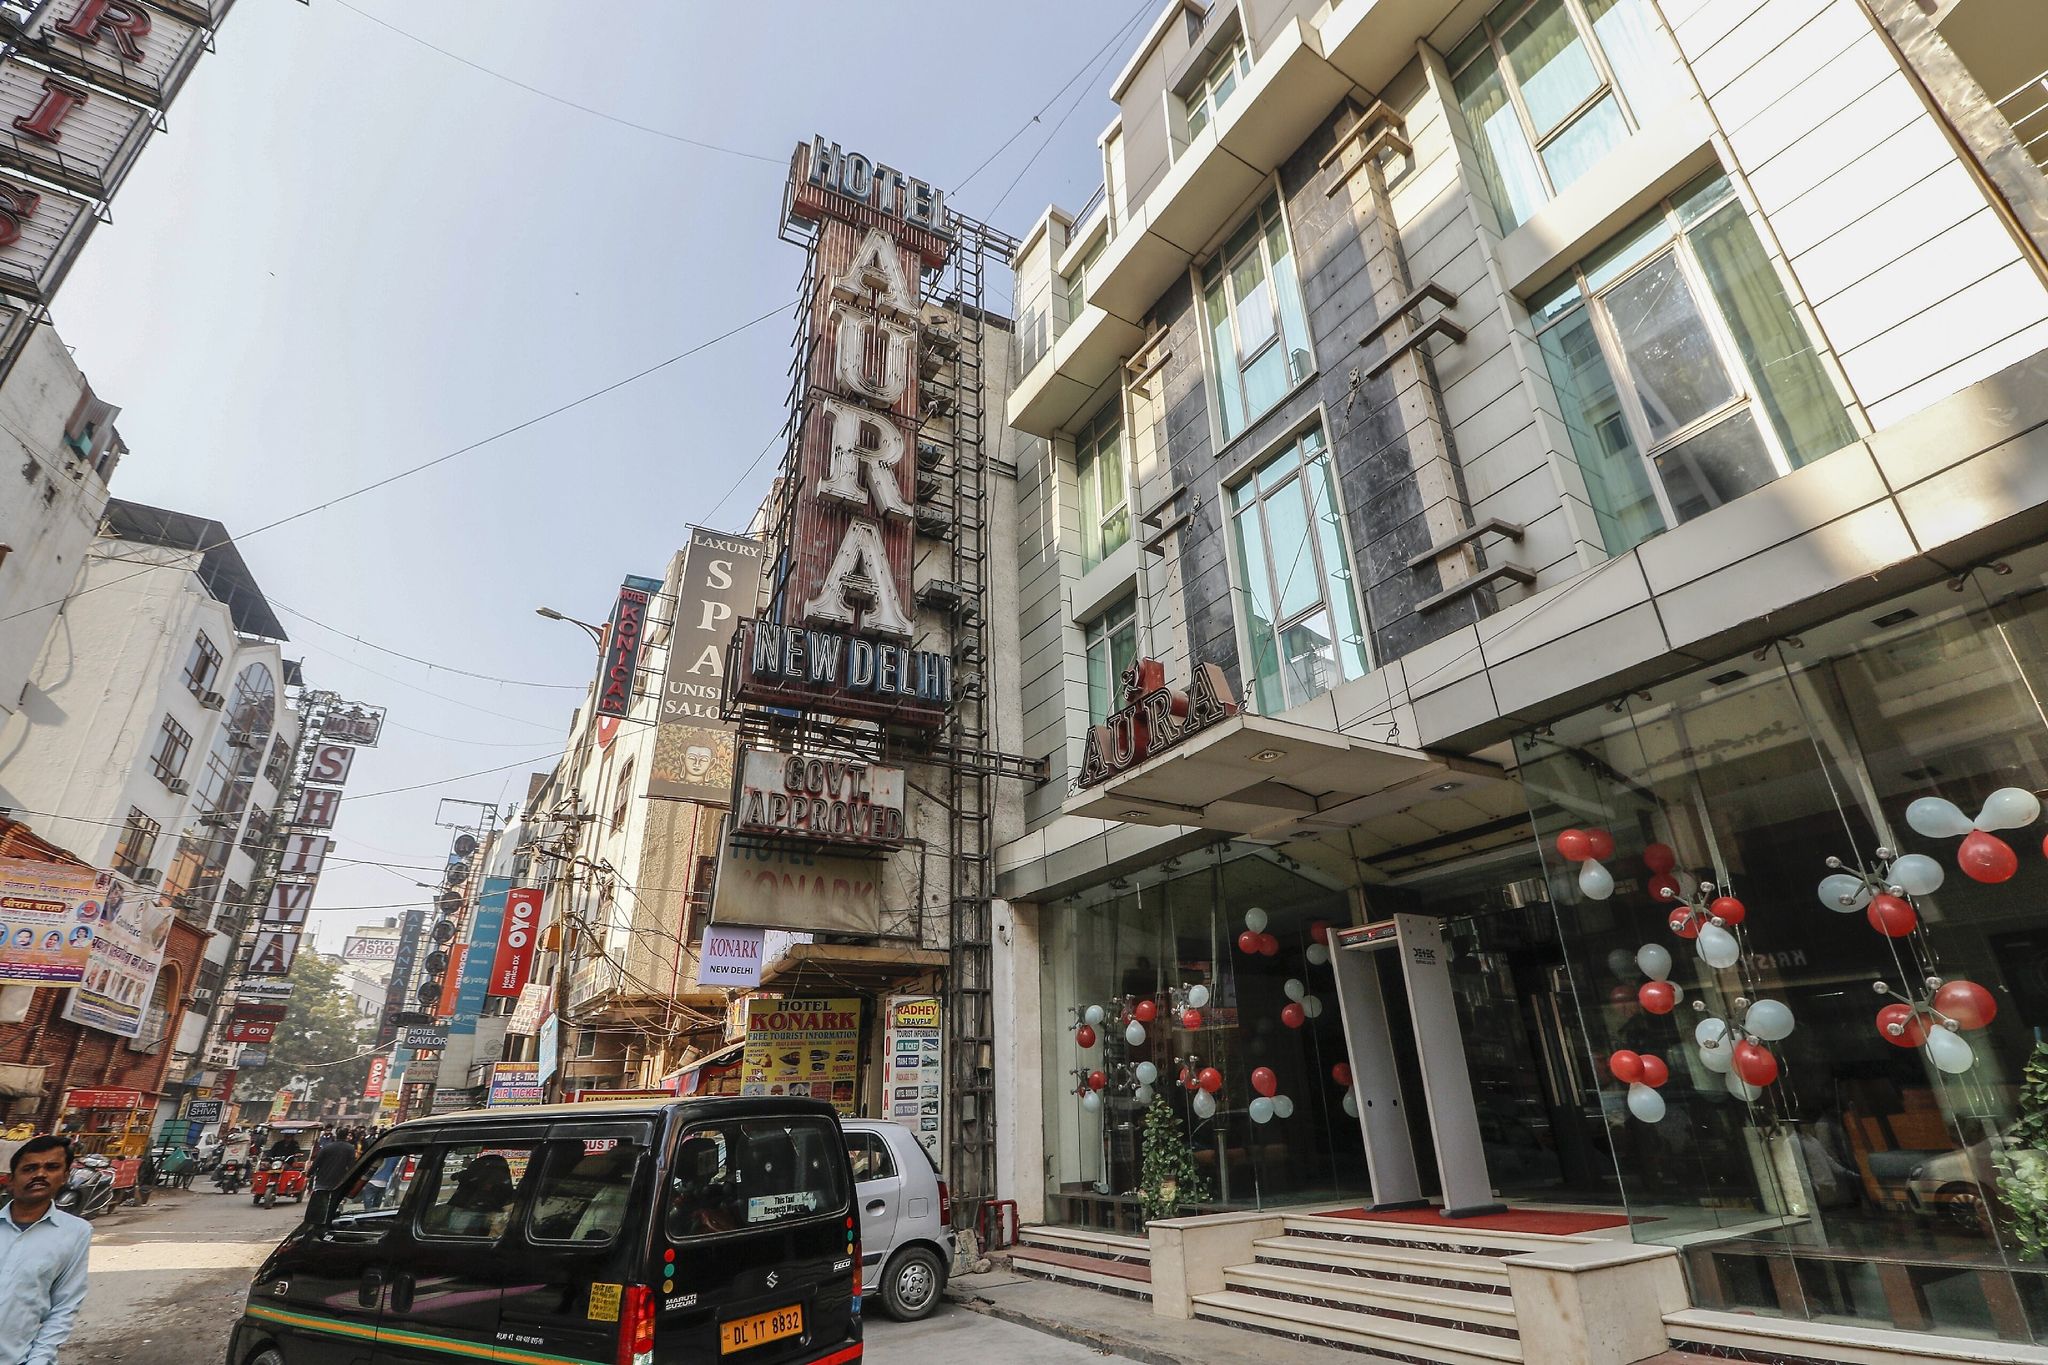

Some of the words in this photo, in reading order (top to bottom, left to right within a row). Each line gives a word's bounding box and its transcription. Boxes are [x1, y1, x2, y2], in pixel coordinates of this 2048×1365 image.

[807, 134, 955, 242] HOTEL
[803, 226, 919, 639] AURA
[694, 535, 760, 559] LAXURY
[620, 591, 648, 604] HOTEL
[607, 604, 640, 699] KONICA
[752, 621, 843, 684] NEW
[845, 639, 952, 703] DELHI
[602, 698, 624, 711] DX
[325, 716, 371, 736] HOTEL
[1078, 661, 1236, 788] AURA
[741, 791, 903, 840] APPROVED
[250, 746, 348, 972] SHIVA
[508, 901, 533, 948] OYO
[391, 911, 419, 987] ATLANTA
[709, 938, 760, 959] KONARK
[513, 954, 521, 965] DX
[710, 965, 731, 974] NEW
[731, 966, 753, 975] DELHI
[502, 970, 512, 989] Hotel
[509, 965, 519, 989] Konica
[777, 1000, 833, 1012] HOTEL
[897, 1005, 937, 1016] RADHEY
[750, 1012, 857, 1032] KONARK
[248, 1027, 270, 1035] OYO
[409, 1028, 437, 1036] HOTEL
[748, 1032, 769, 1041] FREE
[770, 1031, 803, 1040] TOURIST
[805, 1031, 857, 1040] INFORMATION
[896, 1030, 914, 1038] TOURIST
[914, 1029, 940, 1038] INFORMATION
[896, 1042, 905, 1051] AIR
[905, 1042, 919, 1051] TICKET
[371, 1062, 383, 1084] OYO
[493, 1088, 509, 1099] AIR
[511, 1088, 543, 1098] TICKET
[190, 1107, 217, 1116] SHIVA
[896, 1105, 904, 1114] BUS
[904, 1105, 918, 1114] TICKET
[774, 1197, 785, 1205] This
[834, 1259, 851, 1272] EECO
[665, 1293, 698, 1304] MARUTI
[665, 1299, 697, 1311] SUZUKI
[734, 1322, 748, 1345] DL
[753, 1319, 765, 1339] 1T
[772, 1311, 799, 1334] 8832
